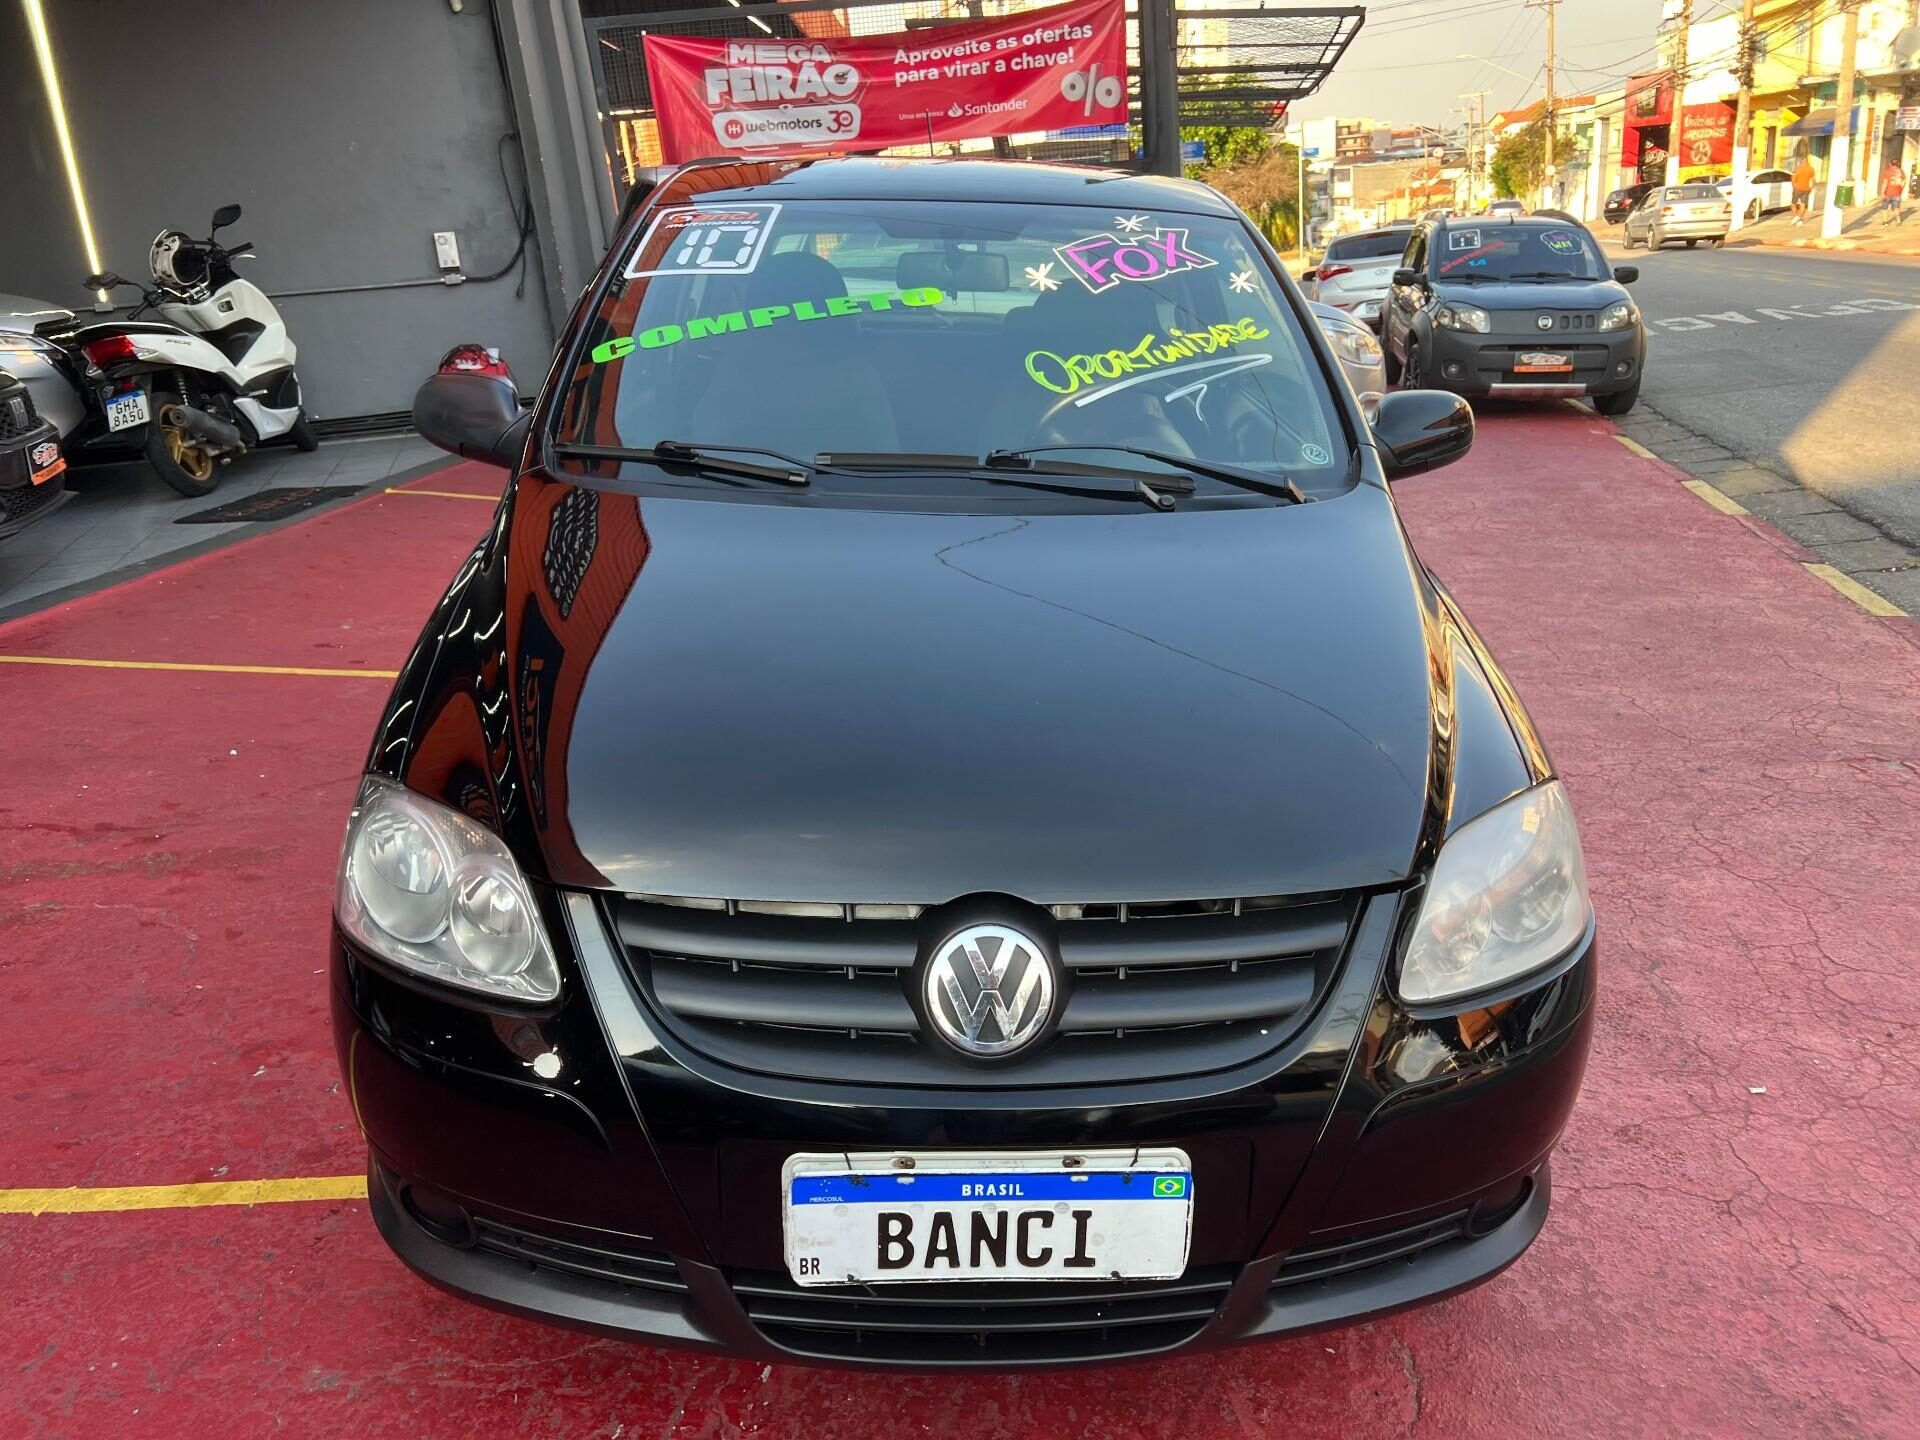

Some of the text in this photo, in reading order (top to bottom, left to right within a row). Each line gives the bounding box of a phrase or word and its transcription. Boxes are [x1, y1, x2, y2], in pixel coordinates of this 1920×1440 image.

[728, 43, 833, 65] MEGA
[893, 24, 1093, 66] Aproveite as ofertas
[704, 61, 860, 105] FEIRÃO
[894, 46, 1075, 87] para virar a chave!
[745, 117, 823, 132] webmotors
[964, 99, 1028, 117] Santander
[676, 225, 759, 268] 10
[1065, 231, 1202, 284] FOX
[591, 287, 944, 364] COMPLETO
[1024, 317, 1269, 394] OPORTUNIDADE
[114, 409, 143, 427] 8A50
[116, 399, 138, 414] GHA
[961, 1184, 1024, 1197] BRASIL
[877, 1210, 1095, 1269] BANCI
[800, 1258, 820, 1275] BR
